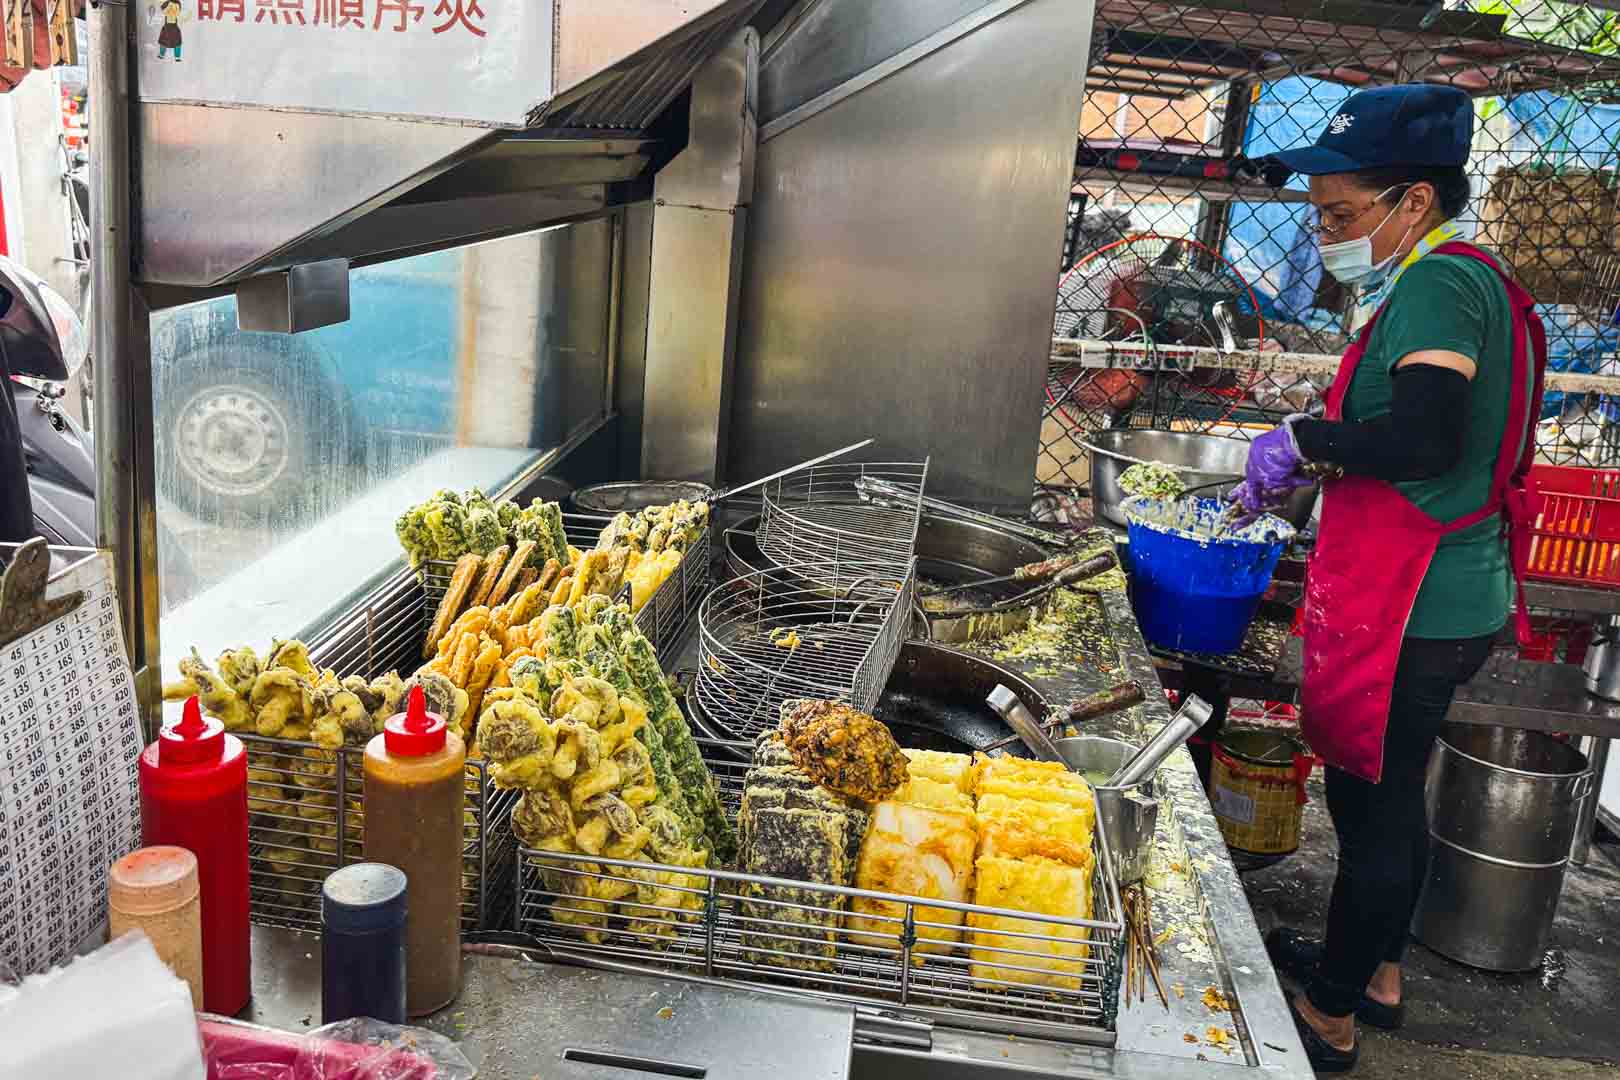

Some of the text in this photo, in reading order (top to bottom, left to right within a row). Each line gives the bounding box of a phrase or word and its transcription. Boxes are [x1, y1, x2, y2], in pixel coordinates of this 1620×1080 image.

[74, 614, 79, 624] 1
[101, 597, 111, 609] 60
[32, 640, 37, 650] 1
[55, 623, 65, 636] 55
[78, 629, 83, 639] 2
[99, 612, 113, 627] 120
[11, 648, 22, 660] 45
[35, 656, 40, 666] 2
[54, 638, 69, 654] 110
[81, 645, 87, 655] 3
[101, 628, 115, 642] 180
[85, 660, 90, 670] 4
[104, 642, 117, 658] 240
[14, 664, 25, 679] 90
[39, 671, 44, 682] 3
[58, 653, 72, 670] 165
[88, 676, 93, 686] 5
[107, 658, 121, 673] 300
[13, 682, 29, 699] 135
[43, 688, 48, 698] 4
[62, 670, 76, 686] 220
[91, 691, 96, 701] 6
[111, 672, 125, 688] 360
[0, 716, 6, 726] 4
[17, 698, 34, 716] 180
[46, 705, 52, 715] 5
[64, 686, 79, 702] 275
[94, 707, 98, 716] 7
[114, 687, 128, 701] 420
[4, 733, 9, 744] 5
[21, 714, 37, 732] 225
[49, 720, 54, 730] 6
[68, 701, 82, 718] 330
[98, 722, 103, 732] 8
[118, 702, 131, 717] 480
[7, 750, 12, 760] 6
[24, 731, 39, 748] 270
[52, 736, 56, 746] 7
[70, 717, 85, 734] 385
[101, 737, 106, 747] 9
[120, 717, 133, 732] 540
[55, 752, 61, 762] 8
[74, 732, 88, 748] 440
[99, 752, 107, 766] 10
[122, 732, 135, 747] 600
[9, 766, 15, 777] 7
[26, 747, 42, 765] 315
[59, 768, 64, 778] 9
[78, 747, 92, 764] 495
[100, 768, 109, 780] 11
[124, 746, 138, 761] 660
[13, 783, 19, 794] 8
[30, 763, 45, 781] 360
[57, 783, 67, 798] 10
[80, 763, 94, 780] 550
[102, 783, 111, 796] 12
[16, 799, 22, 810] 9
[34, 779, 49, 796] 405
[59, 800, 68, 813] 11
[82, 778, 95, 795] 605
[104, 797, 114, 811] 13
[13, 816, 24, 831] 10
[36, 795, 52, 812] 450
[60, 815, 70, 829] 12
[83, 793, 97, 810] 660
[106, 811, 115, 826] 14
[15, 833, 25, 848] 11
[38, 810, 53, 828] 495
[62, 830, 71, 844] 13
[85, 808, 99, 825] 715
[107, 826, 116, 840] 15
[17, 848, 27, 862] 12
[39, 826, 54, 845] 540
[64, 823, 101, 860] 14 770
[19, 842, 56, 879] 13 585
[65, 840, 103, 875] 15 825
[20, 858, 58, 895] 14 630
[44, 873, 59, 891] 675
[66, 875, 75, 889] 16
[67, 890, 76, 905] 17
[22, 911, 32, 926] 16
[24, 926, 33, 942] 17
